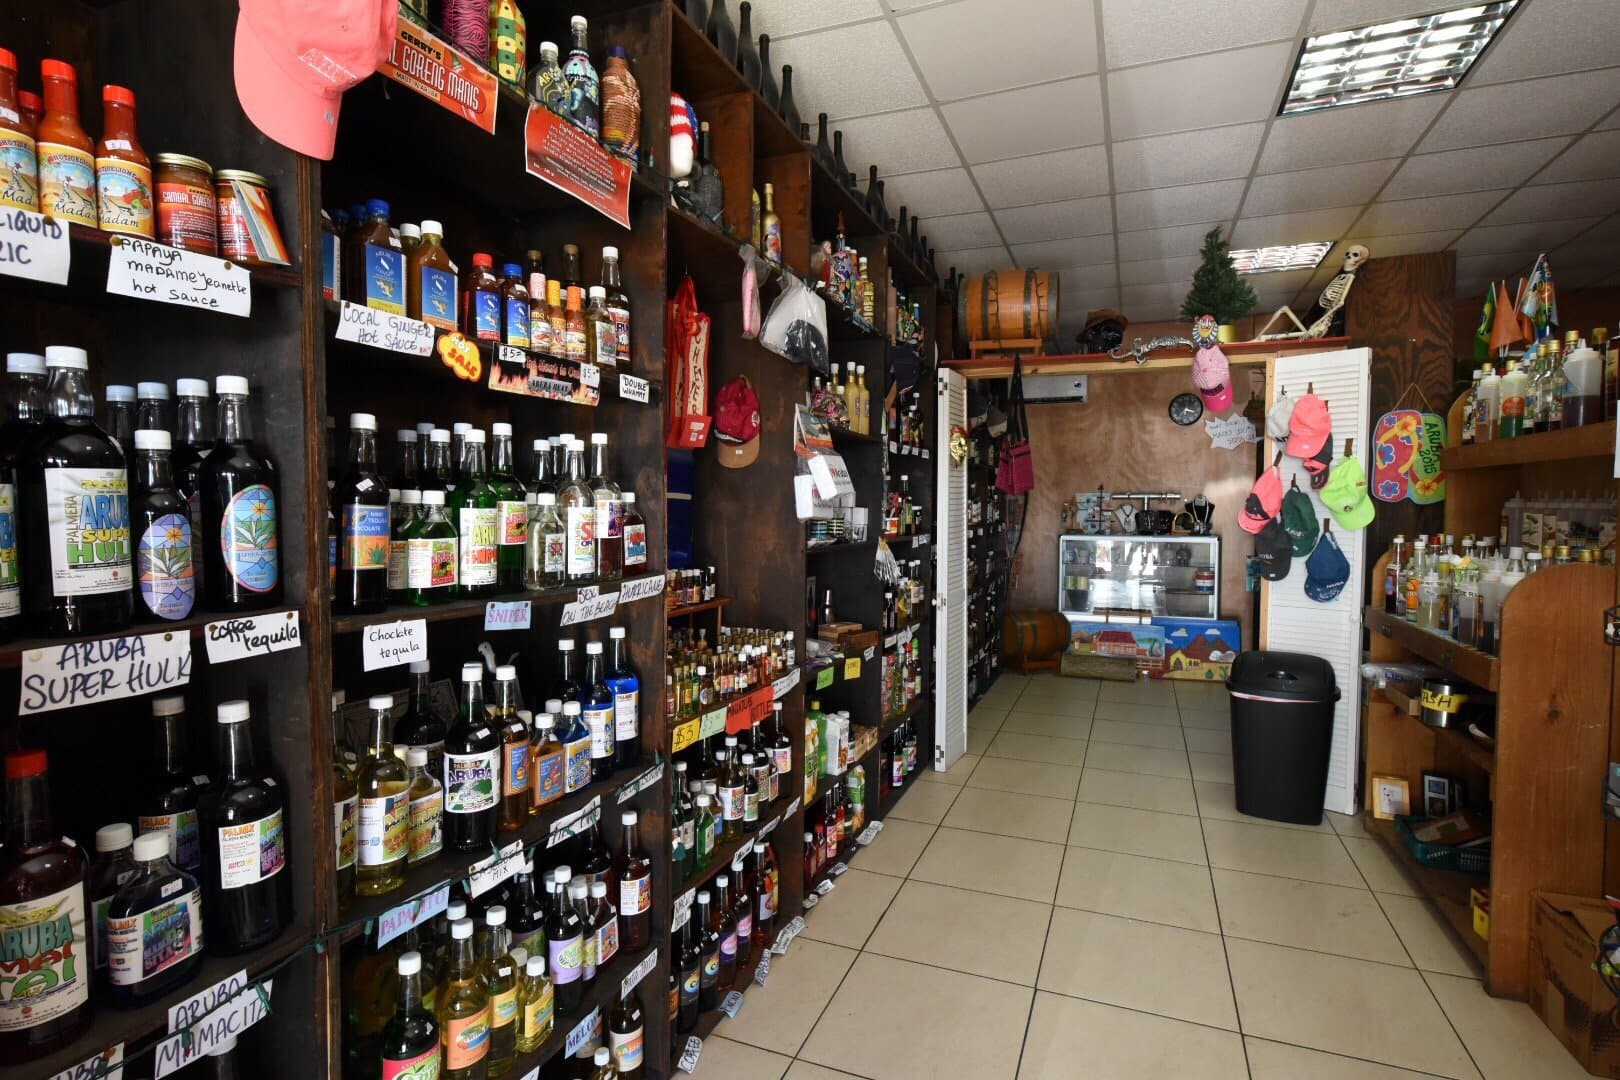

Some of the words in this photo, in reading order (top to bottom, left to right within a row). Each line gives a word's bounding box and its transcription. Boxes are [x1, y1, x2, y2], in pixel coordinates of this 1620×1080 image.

[400, 30, 442, 60] GERRY'S
[402, 45, 445, 91] GORENG
[446, 72, 480, 110] MANIS
[132, 278, 157, 294] hot
[388, 316, 434, 341] GINGER
[447, 347, 478, 377] SALE
[623, 376, 647, 392] DOUBLE
[1424, 422, 1441, 463] ARUBA
[1419, 448, 1437, 474] 2015
[63, 491, 80, 544] PALMERA
[487, 606, 528, 623] SNIPER
[209, 619, 256, 643] coffee
[56, 635, 146, 670] ARUBA
[23, 669, 121, 711] SUPER
[125, 652, 192, 693] HULK
[447, 767, 493, 786] ARUBA
[491, 866, 509, 881] MIX
[175, 978, 243, 1030] ARUBA
[567, 1014, 599, 1051] MELON
[680, 1037, 701, 1072] COFFEE
